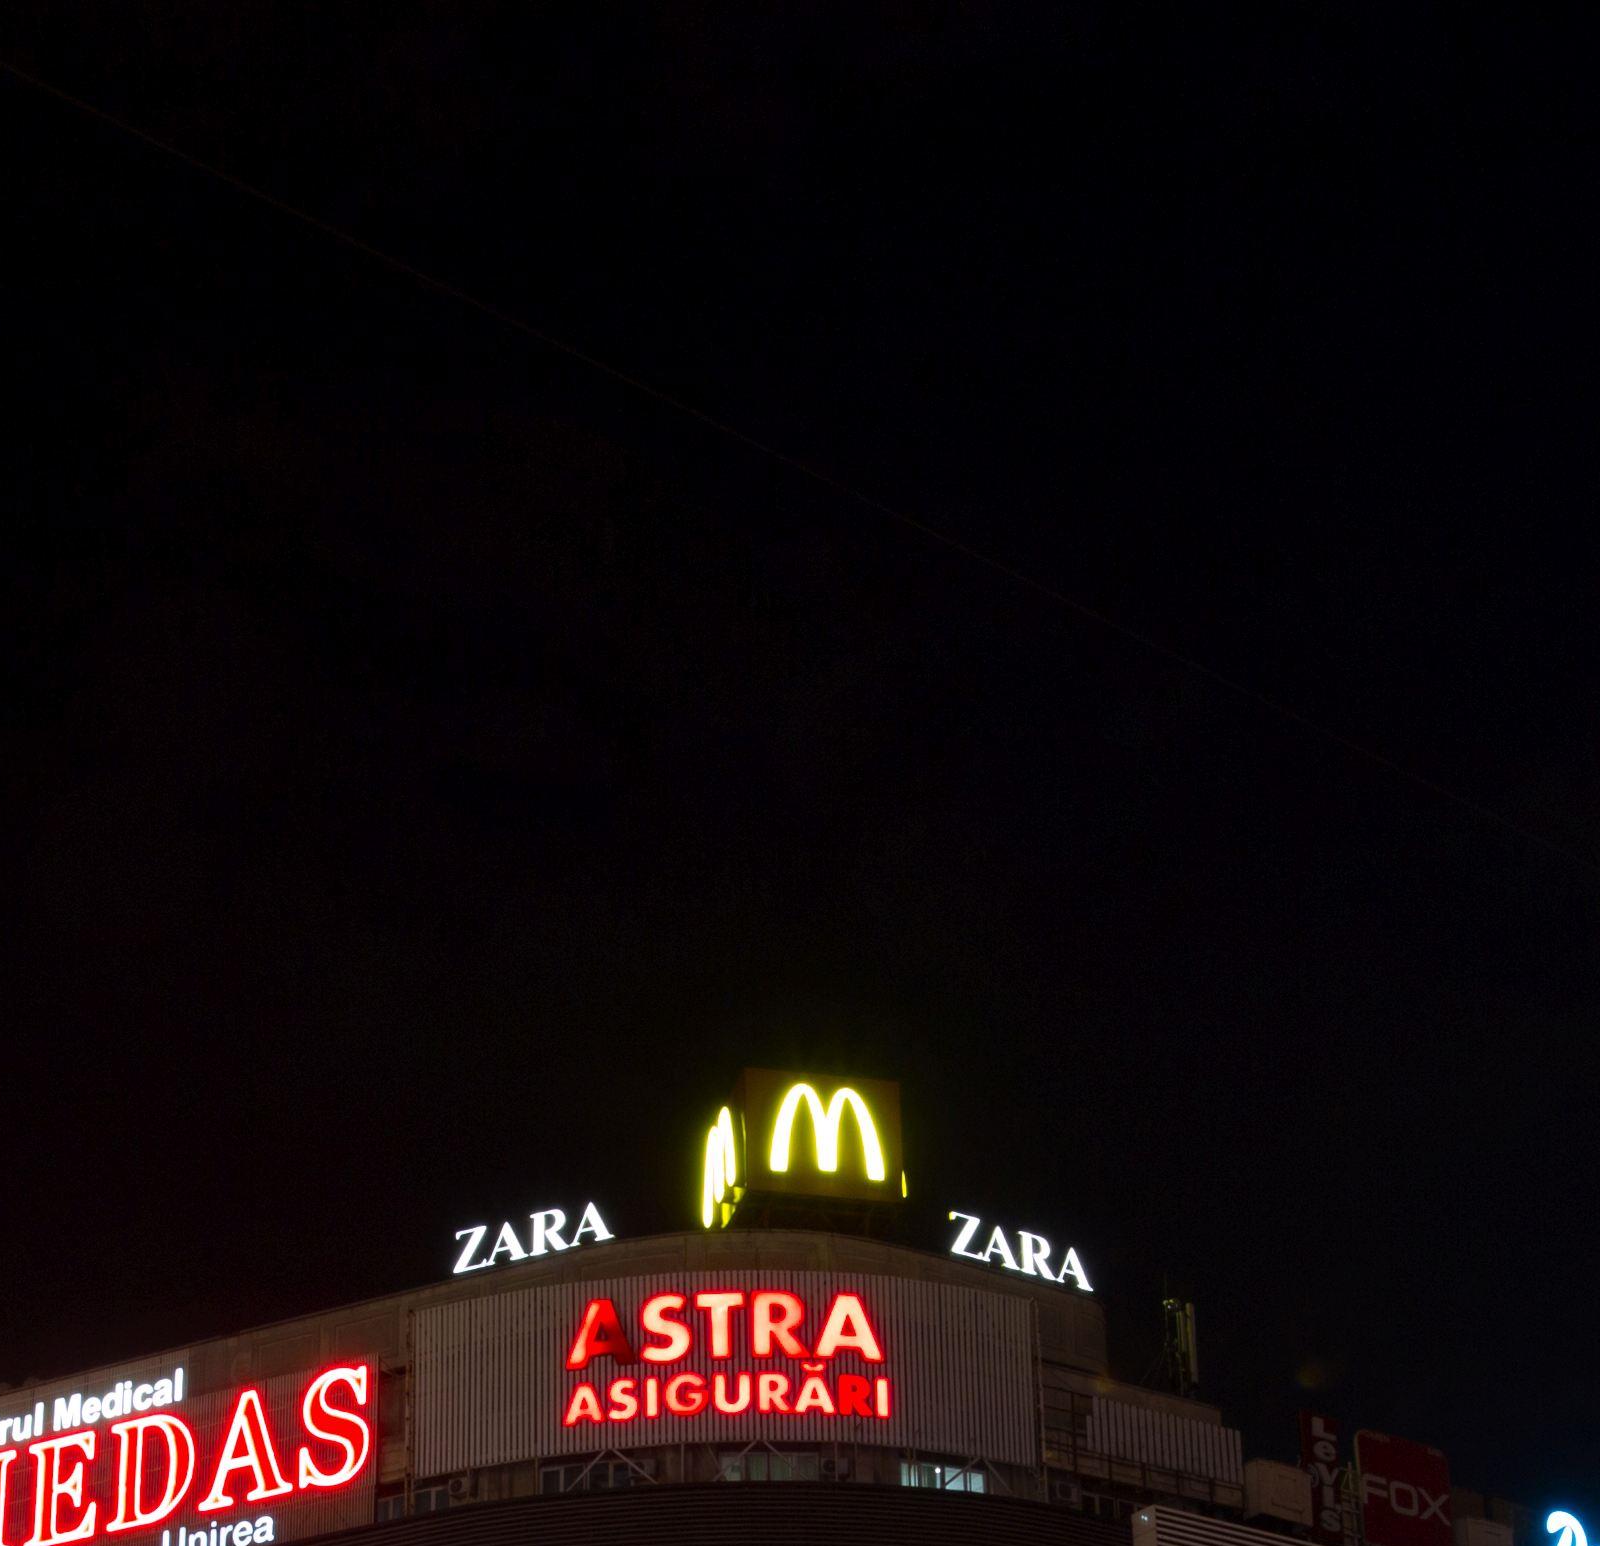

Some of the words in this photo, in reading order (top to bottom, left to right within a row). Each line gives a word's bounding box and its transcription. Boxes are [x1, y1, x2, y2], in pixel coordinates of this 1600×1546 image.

[453, 1202, 615, 1275] ZARA
[948, 1210, 1094, 1291] ZARA
[564, 1288, 886, 1372] ASTRA
[53, 1367, 185, 1432] Medical
[562, 1362, 891, 1428] ASIGURĂRI
[1361, 1473, 1453, 1528] FOX
